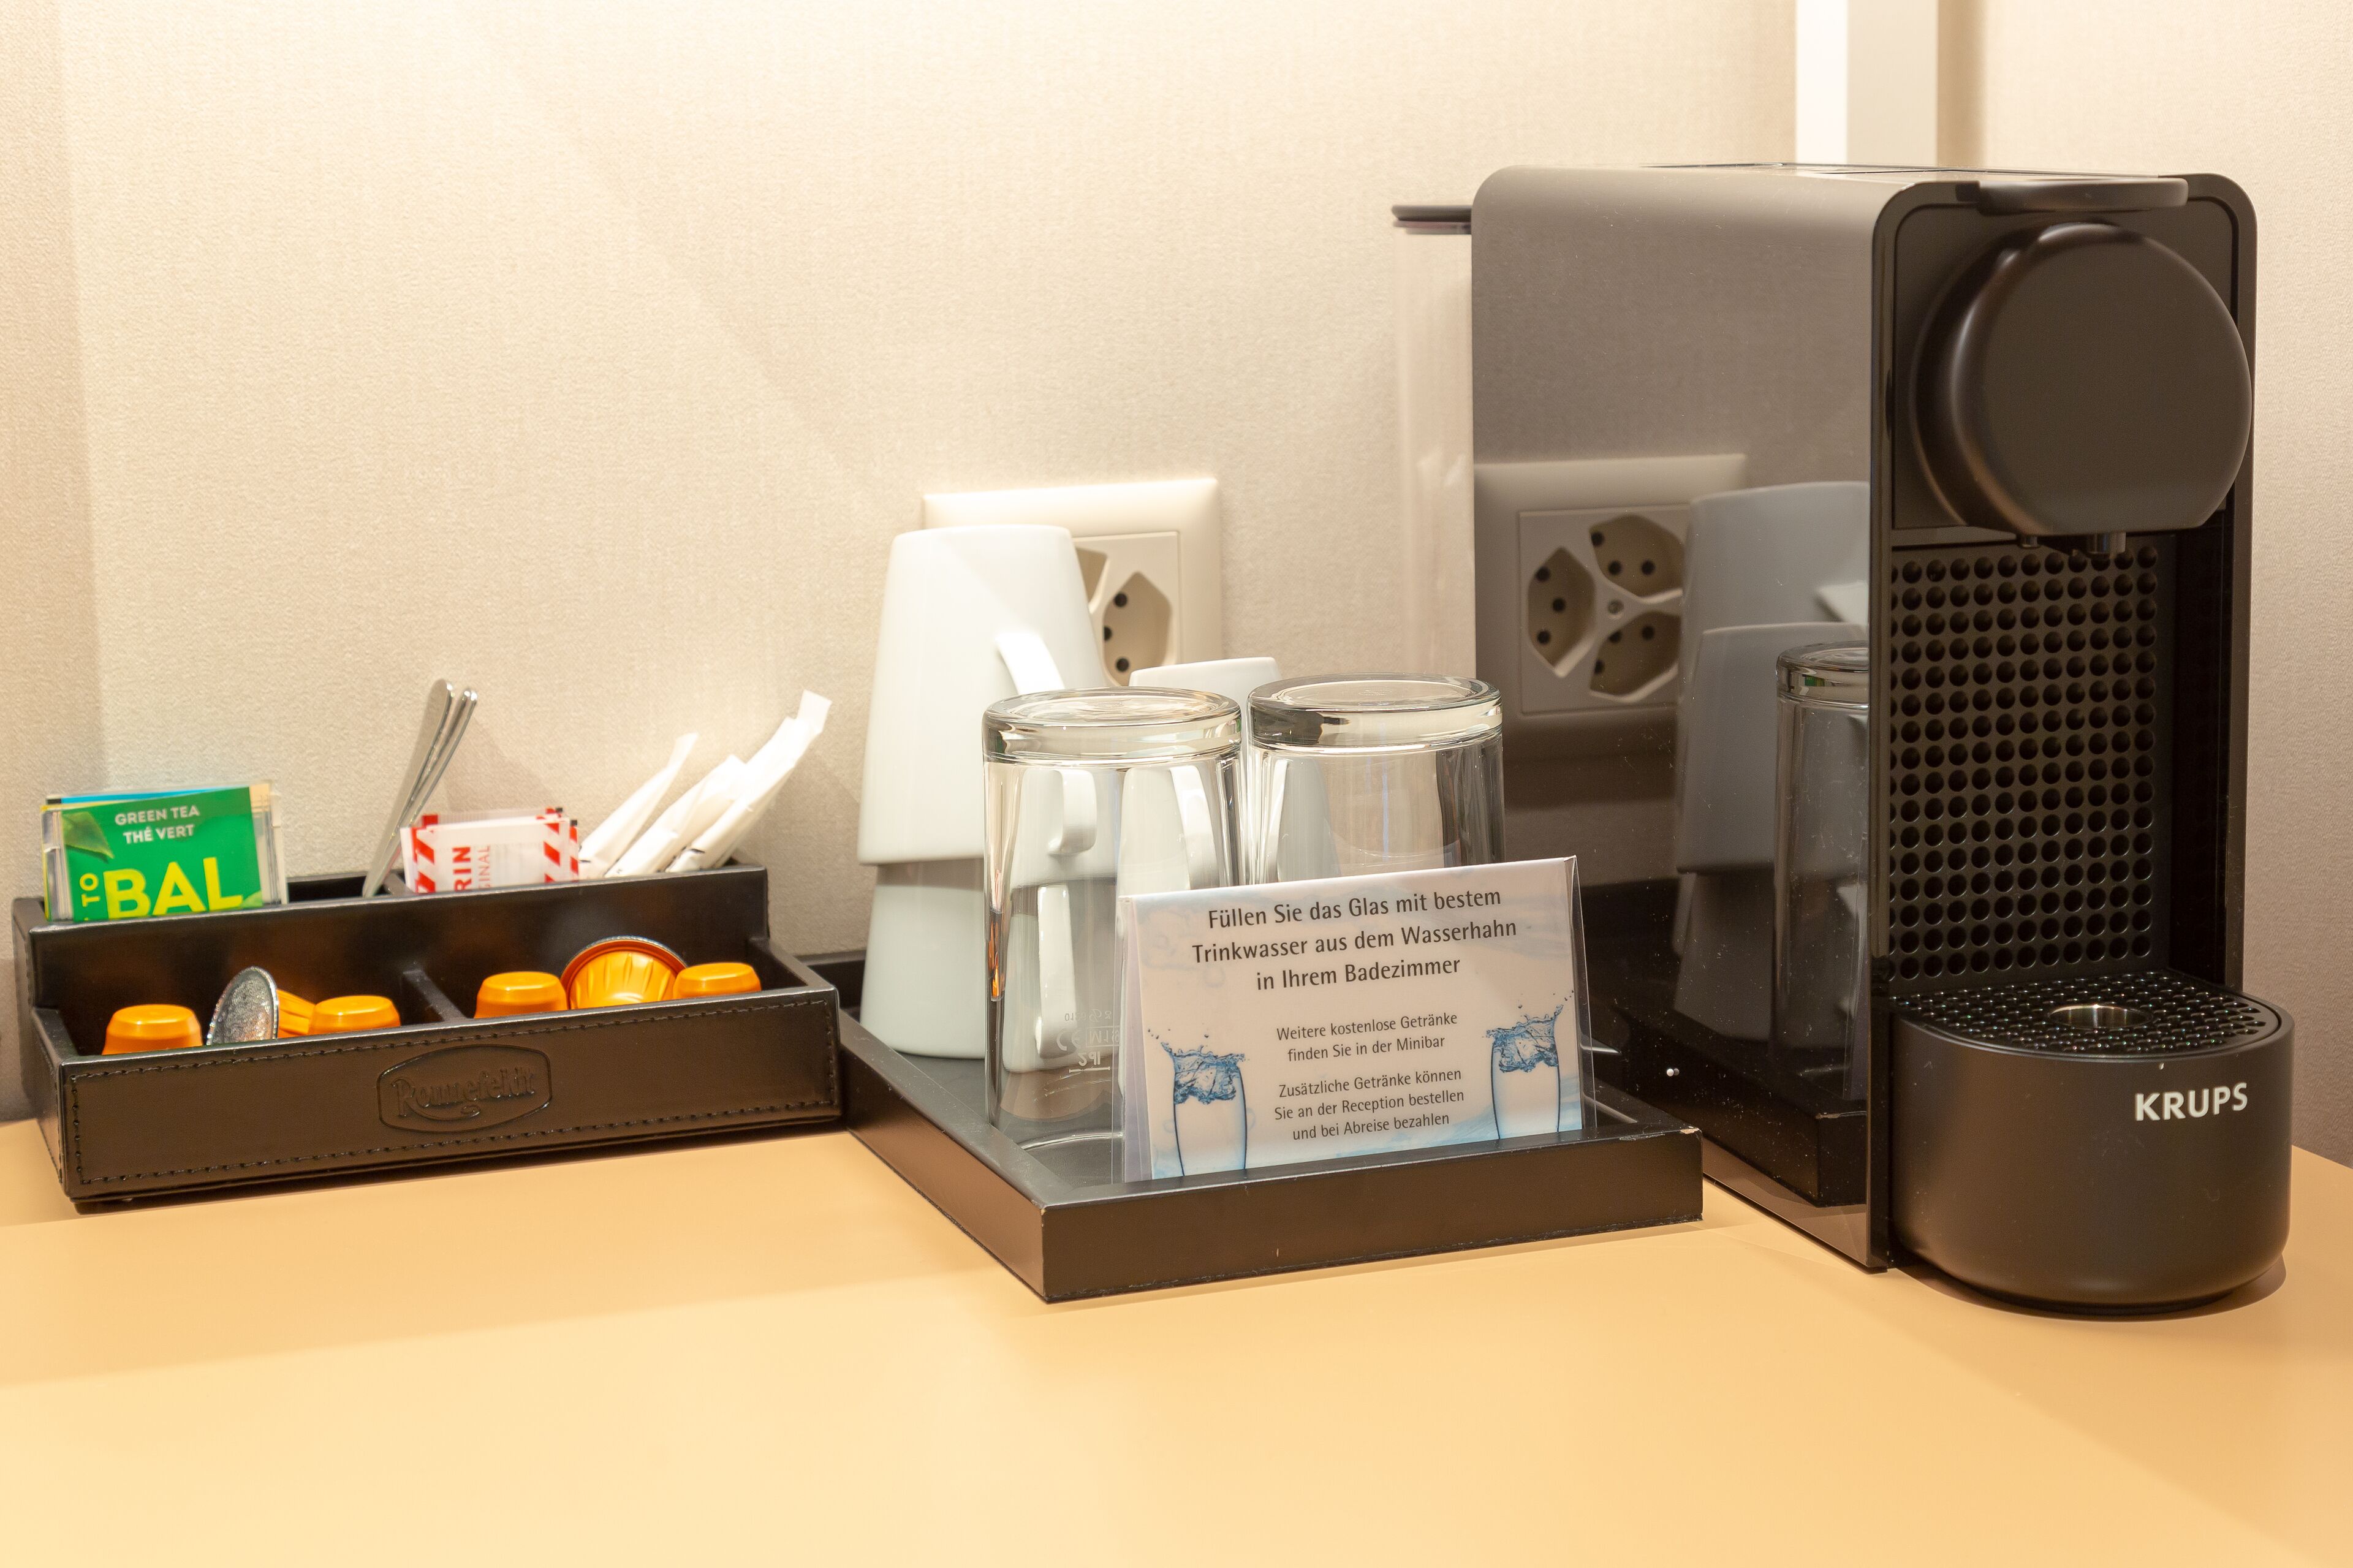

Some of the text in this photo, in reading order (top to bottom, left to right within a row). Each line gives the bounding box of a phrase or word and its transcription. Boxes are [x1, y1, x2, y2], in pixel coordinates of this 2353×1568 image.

[115, 805, 200, 825] GREEN TEA
[123, 824, 195, 844] THÉ VERT
[452, 847, 472, 892] RIN
[80, 873, 100, 907] TO
[103, 857, 244, 921] BAL
[1208, 890, 1501, 929] Füllen Sie das Glas mit bestem
[1191, 919, 1517, 963] Trinkwasser aus dem Wasserhahn
[1257, 959, 1460, 991] in Ihrem Badezimmer
[1276, 1012, 1458, 1041] Weitere kostenlose Getränke
[1287, 1036, 1446, 1062] finden Sie in der Minibar
[1279, 1070, 1461, 1098] Zusätzliche Getränke können
[1275, 1089, 1464, 1120] Sie an der Reception bestellen
[2135, 1082, 2248, 1121] KRUPS
[1292, 1113, 1449, 1140] und bei Abreise bezahlen
